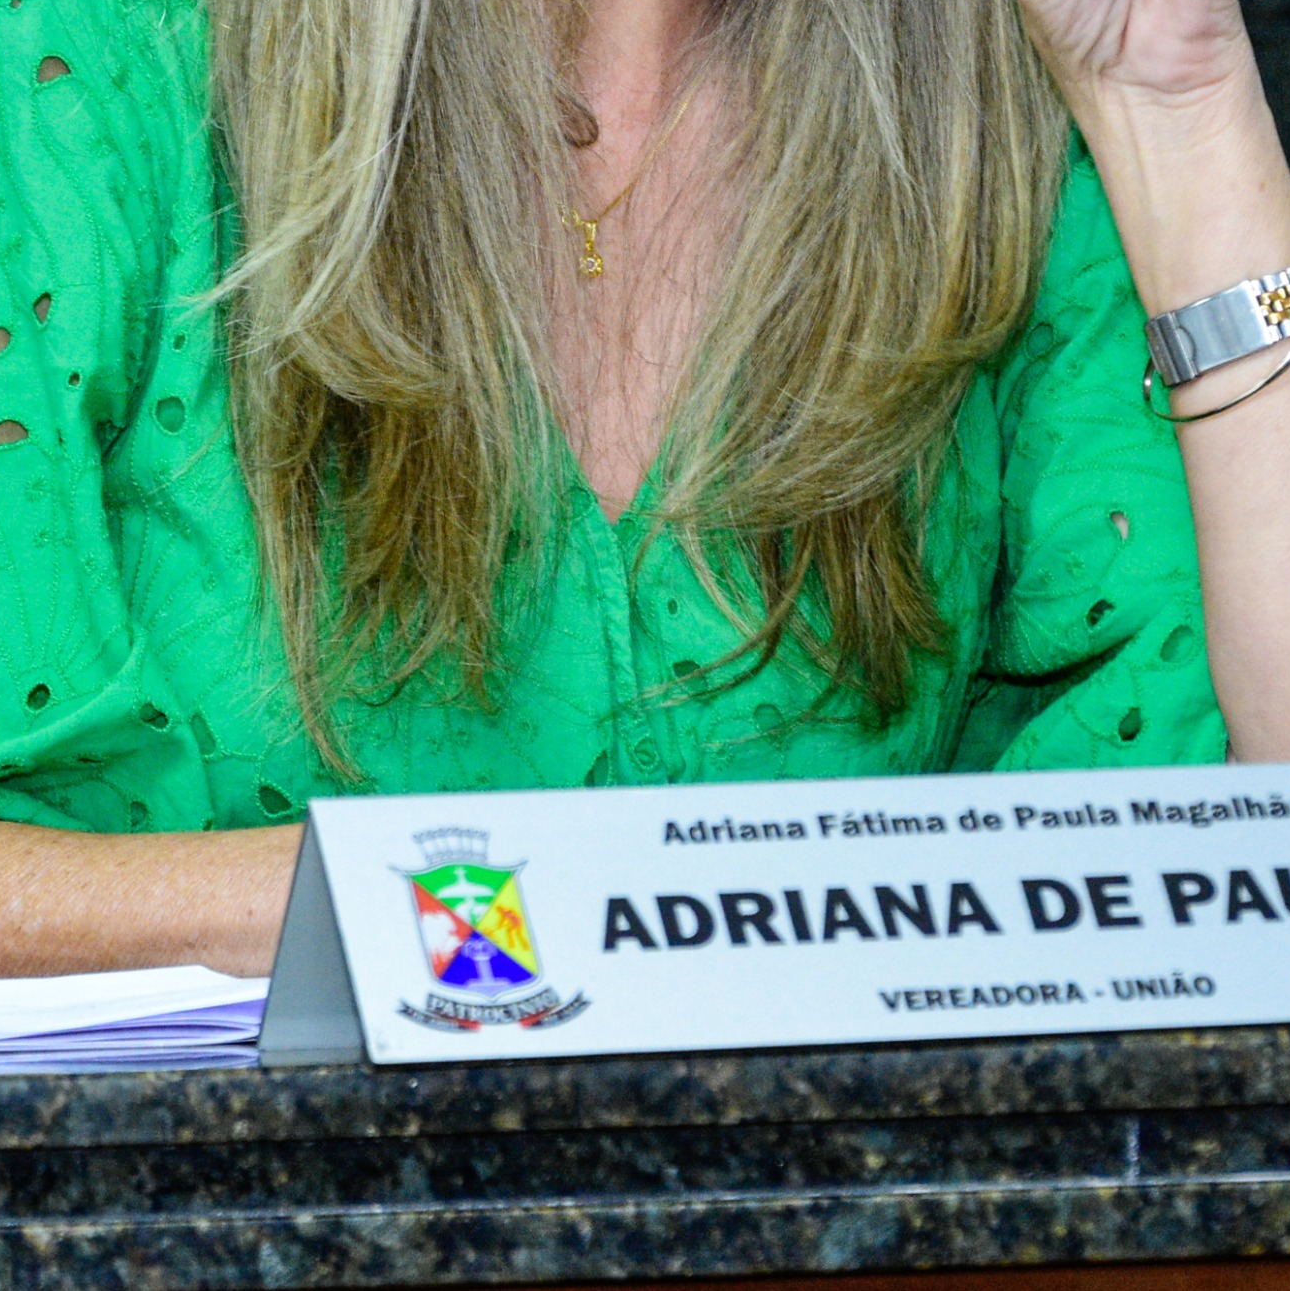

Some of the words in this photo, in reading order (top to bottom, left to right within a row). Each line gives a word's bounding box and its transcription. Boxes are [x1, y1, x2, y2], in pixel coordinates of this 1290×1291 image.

[663, 817, 809, 846] Adriana
[818, 811, 947, 839] Fátima
[958, 807, 1004, 833] de
[1013, 802, 1121, 830] Paula
[603, 881, 1003, 953] ADRIANA
[1020, 875, 1144, 934] DE
[877, 981, 1088, 1012] VEREADORA
[1111, 970, 1217, 1002] UNIÃO
